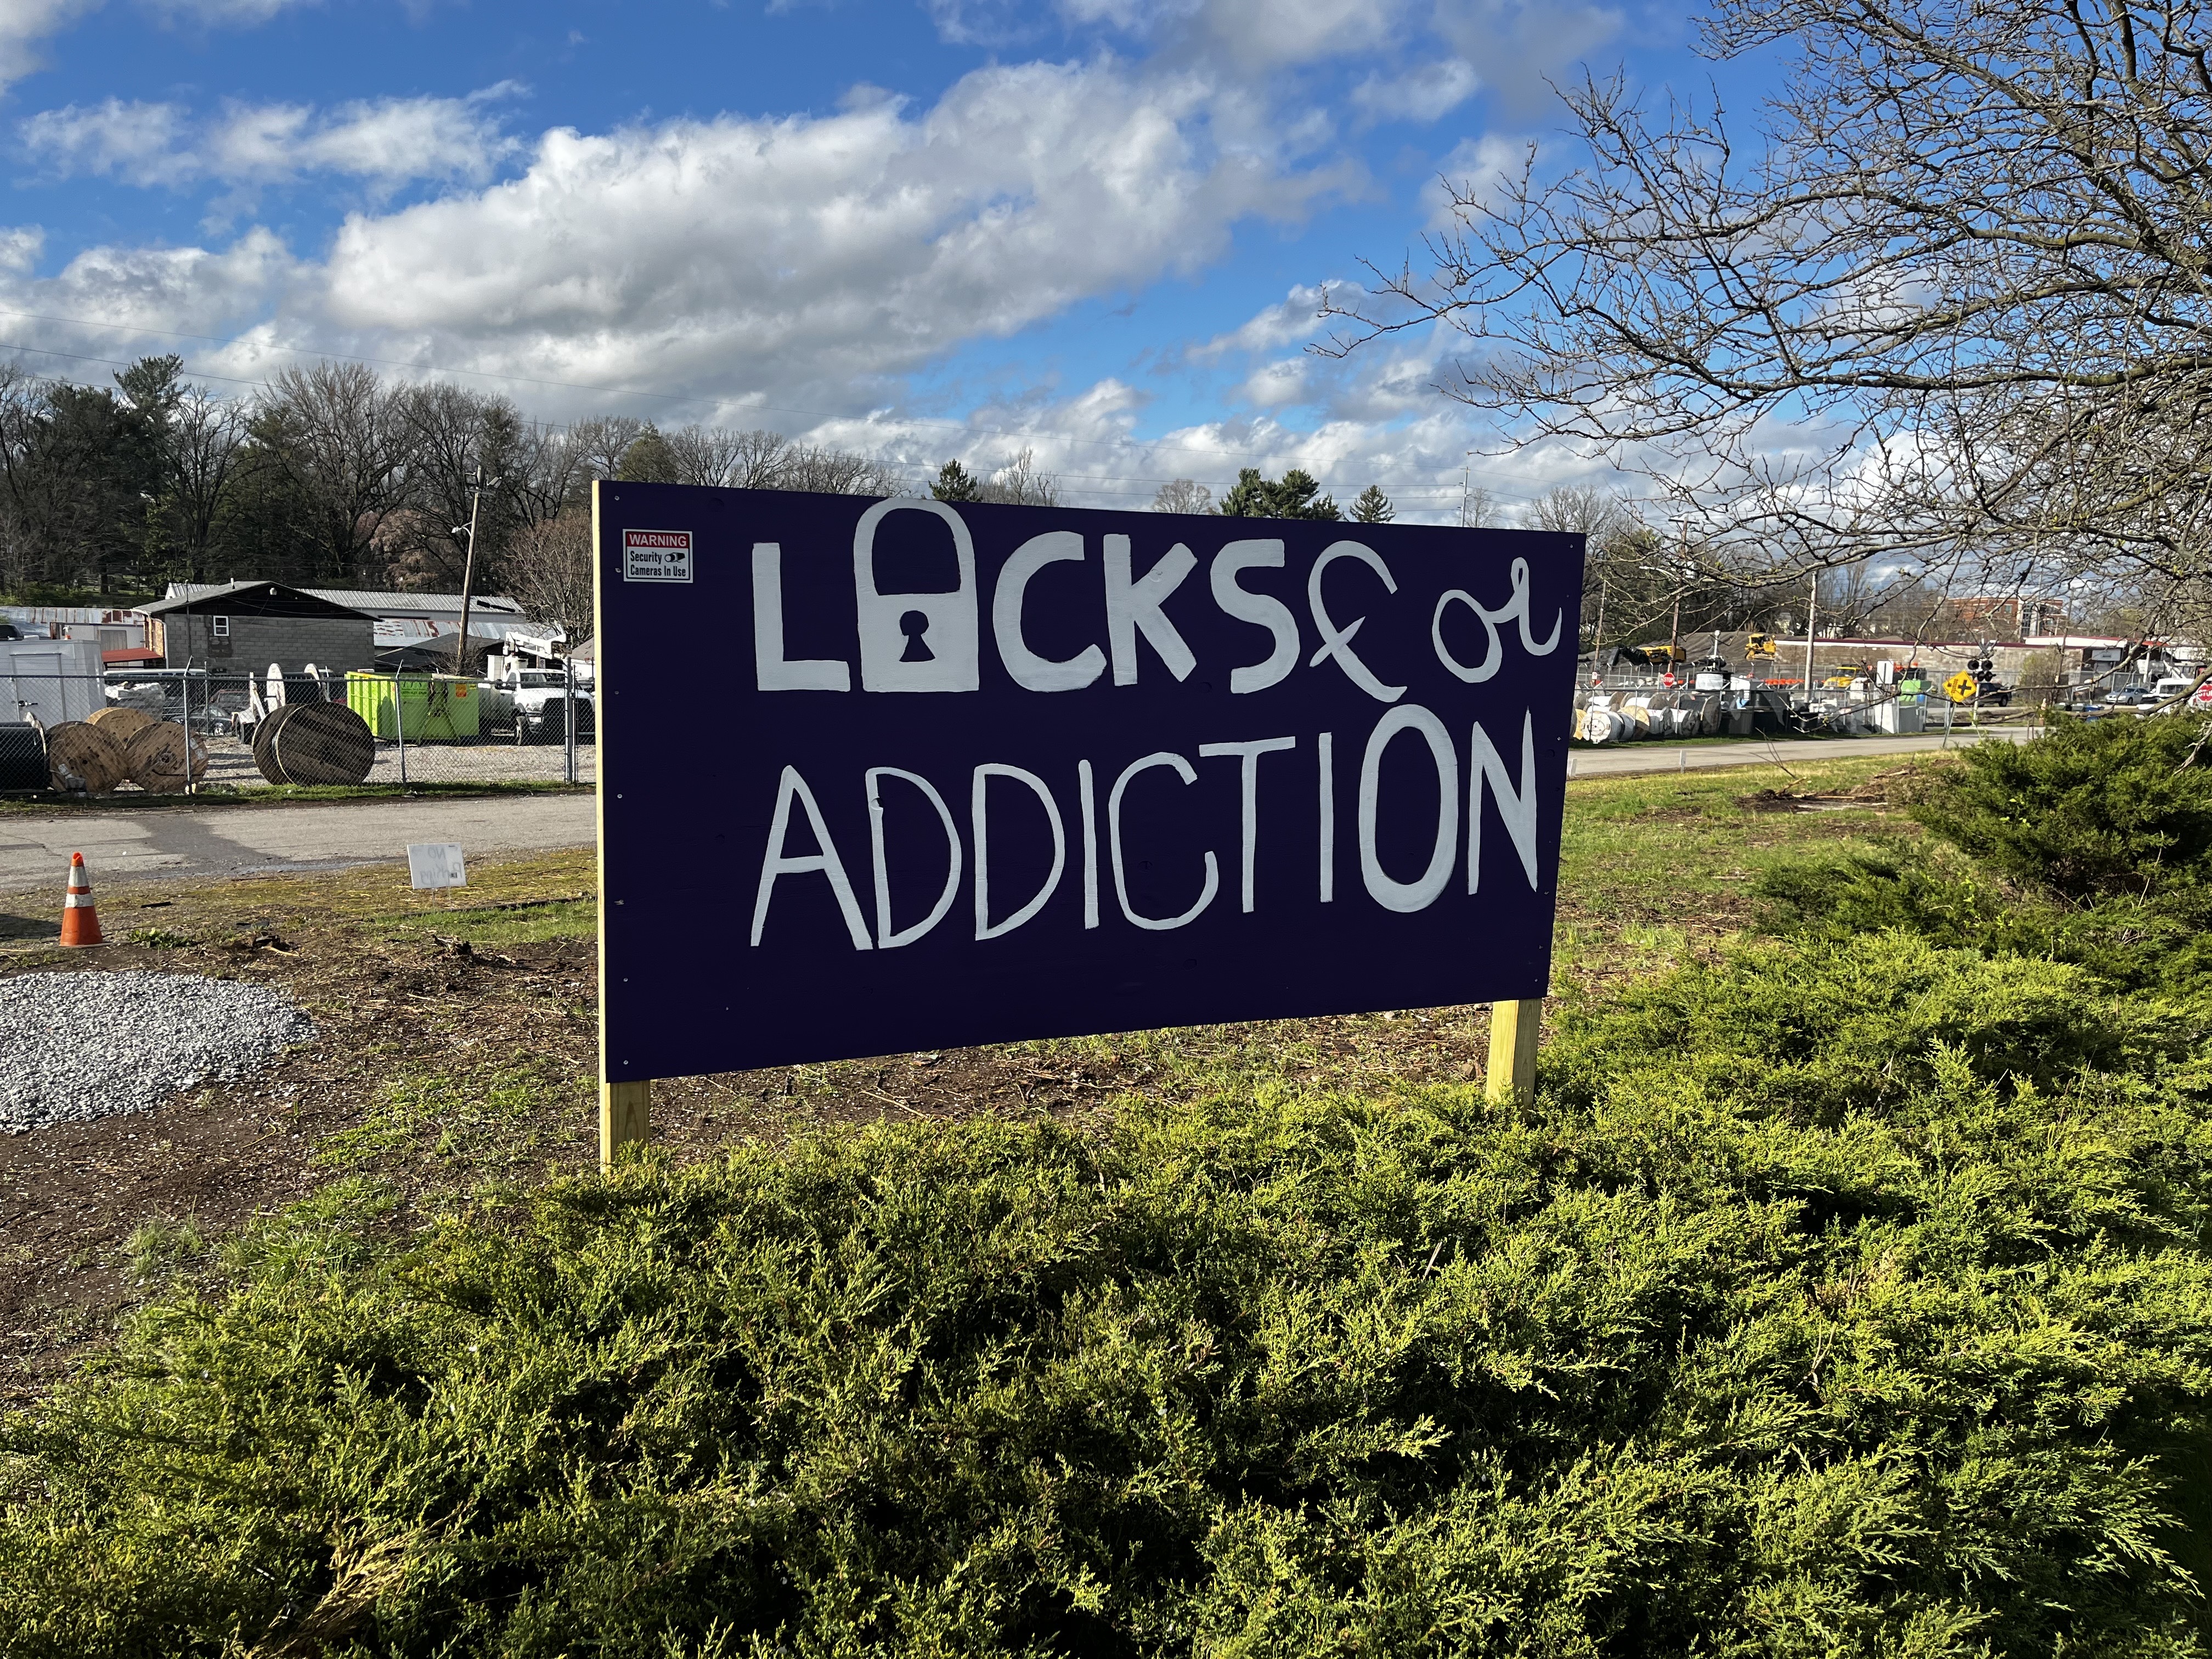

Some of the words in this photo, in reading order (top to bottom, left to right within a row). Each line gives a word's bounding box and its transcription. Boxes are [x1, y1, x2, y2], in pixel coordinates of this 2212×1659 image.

[629, 534, 686, 546] WARNING
[630, 551, 662, 565] Security
[630, 565, 662, 576] Cameras
[664, 566, 671, 576] In
[673, 566, 686, 577] Use
[751, 704, 1538, 951] ADDICTION
